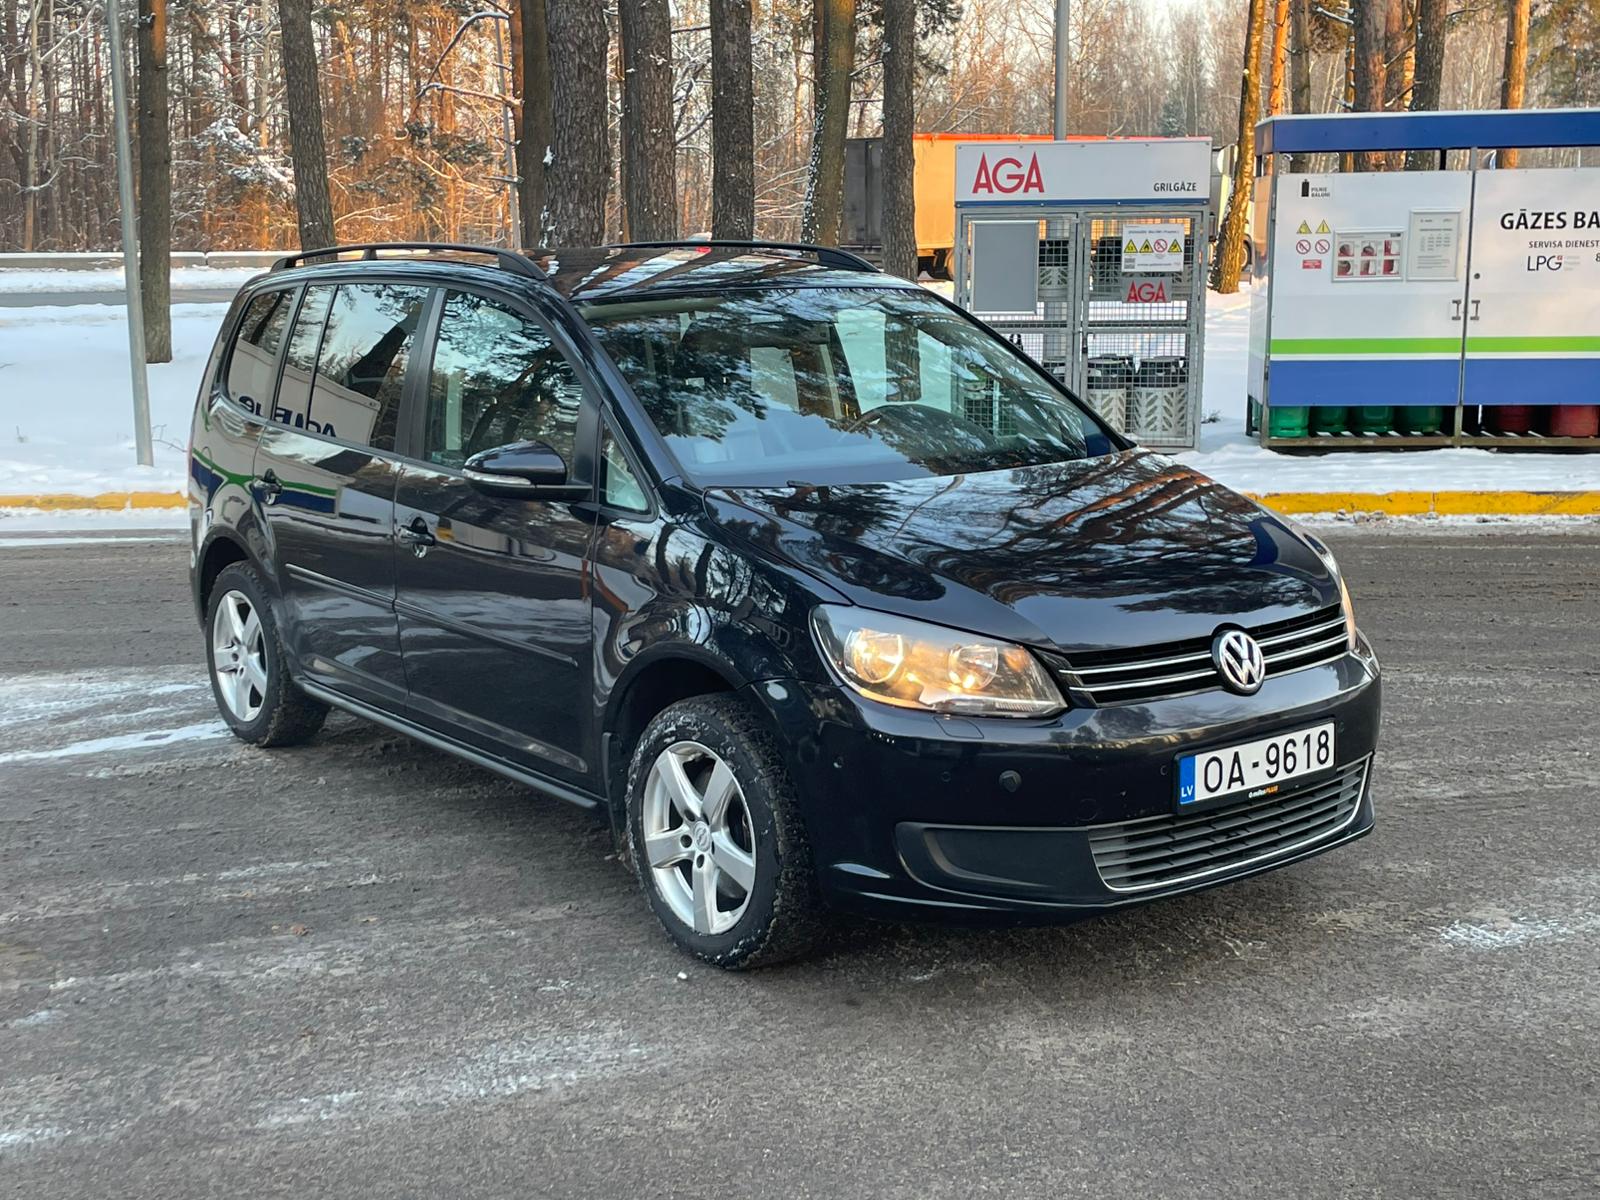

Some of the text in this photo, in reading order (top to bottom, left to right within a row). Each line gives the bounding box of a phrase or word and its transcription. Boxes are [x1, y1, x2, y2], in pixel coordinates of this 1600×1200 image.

[972, 151, 1045, 194] AGA
[1500, 208, 1600, 230] GĀZES BA
[1528, 240, 1563, 249] SERVISA
[1527, 255, 1563, 271] LPG
[1126, 280, 1167, 303] AGA
[1181, 730, 1330, 797] LV OA-9618
